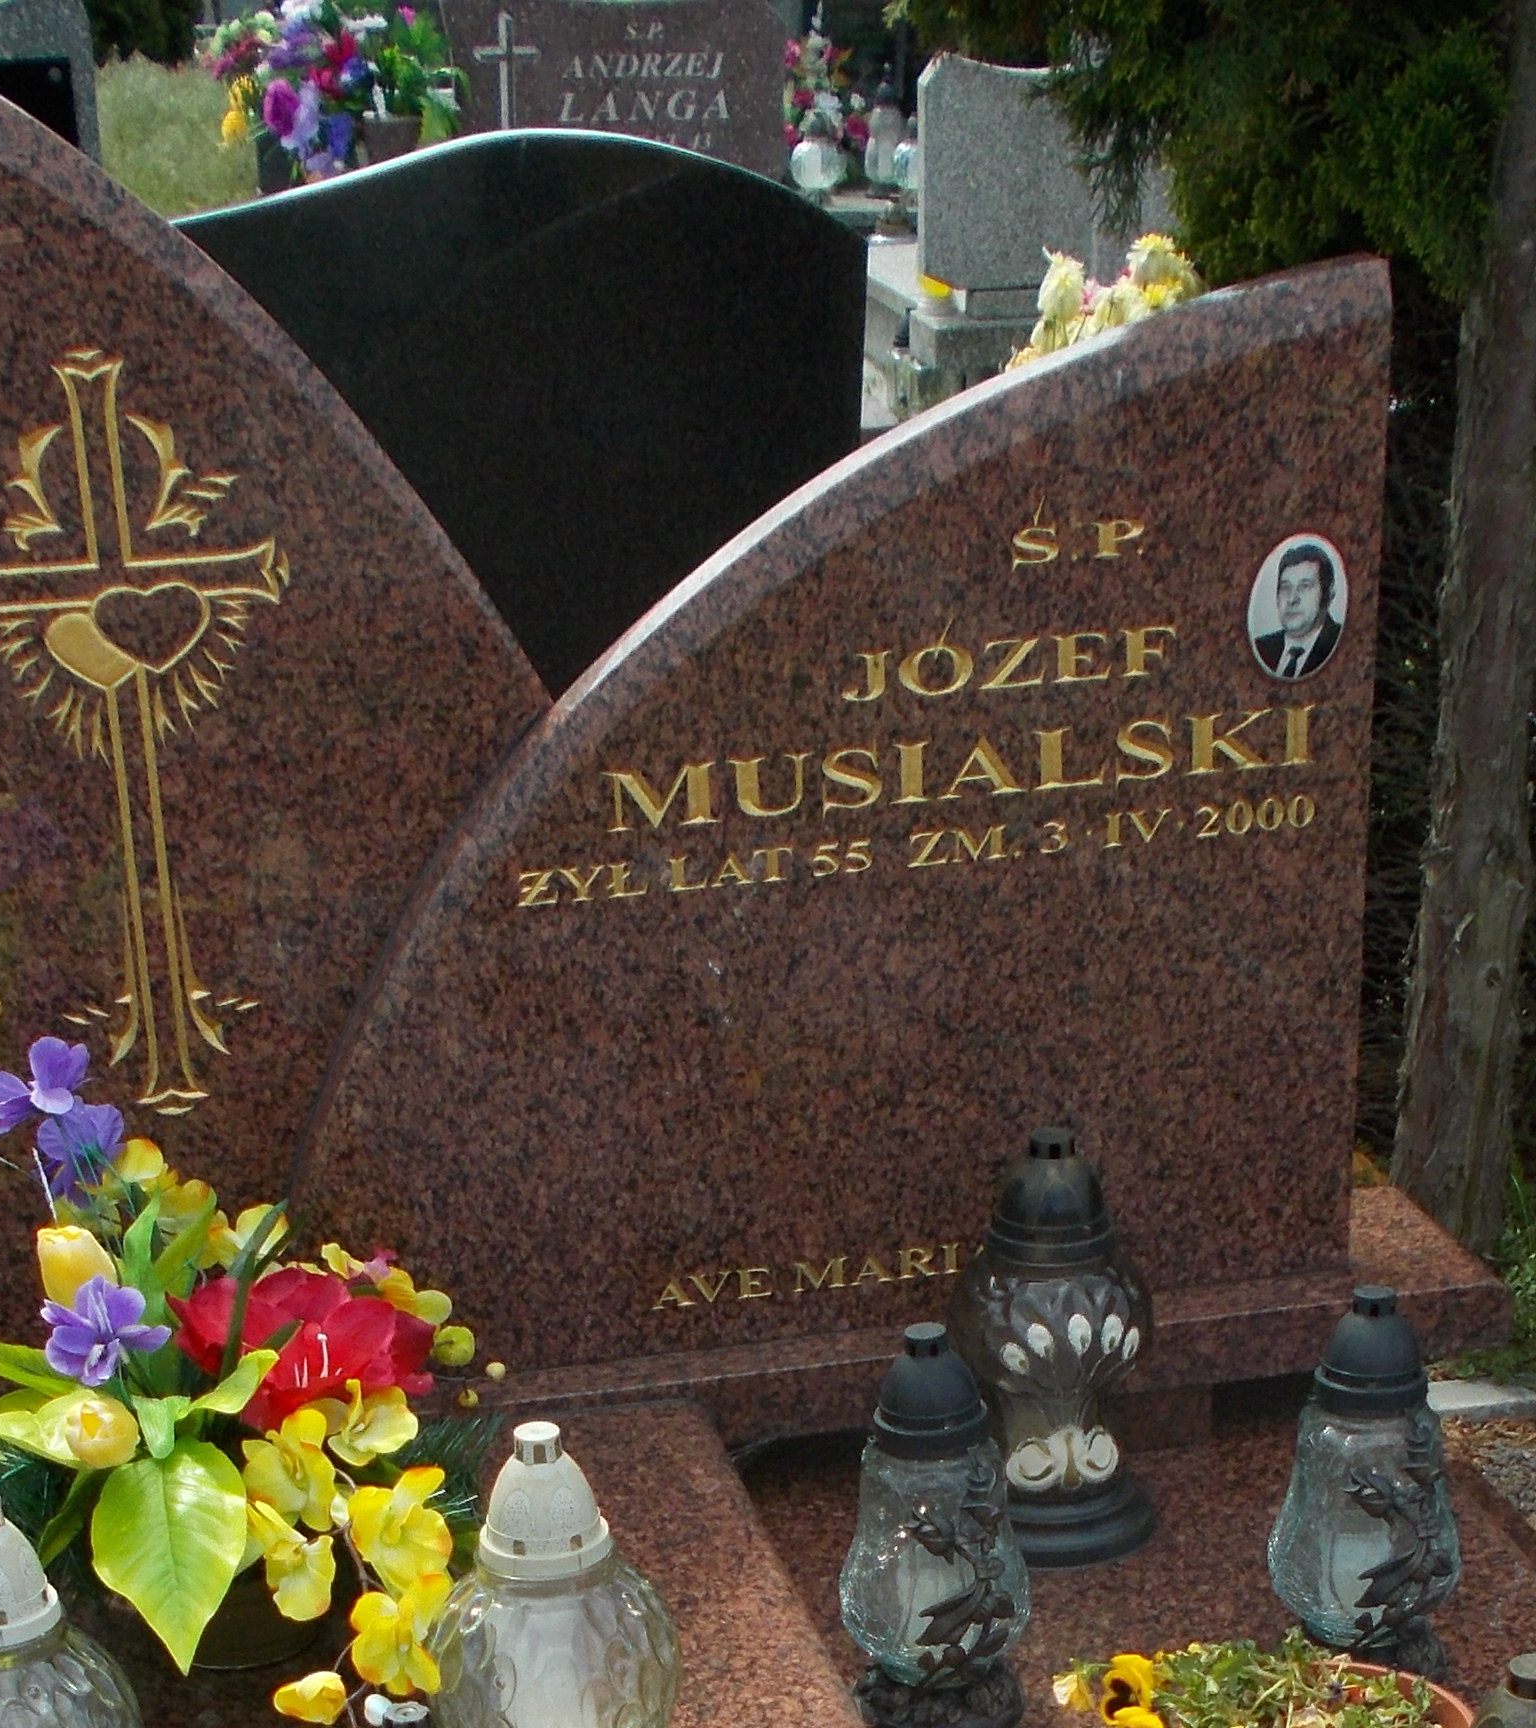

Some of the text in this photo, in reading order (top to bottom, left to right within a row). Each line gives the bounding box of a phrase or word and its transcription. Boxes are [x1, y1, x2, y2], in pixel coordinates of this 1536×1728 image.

[561, 51, 725, 79] ANDRZEJ
[557, 89, 731, 122] LANGA
[841, 614, 1177, 702] JÓZEF
[600, 703, 1316, 832] MUSIALSKI
[666, 846, 794, 892] LAT
[811, 840, 873, 877] 55
[907, 823, 1022, 868] ZM.
[1195, 795, 1316, 838] 2000
[651, 1243, 984, 1311] AVE MARI
